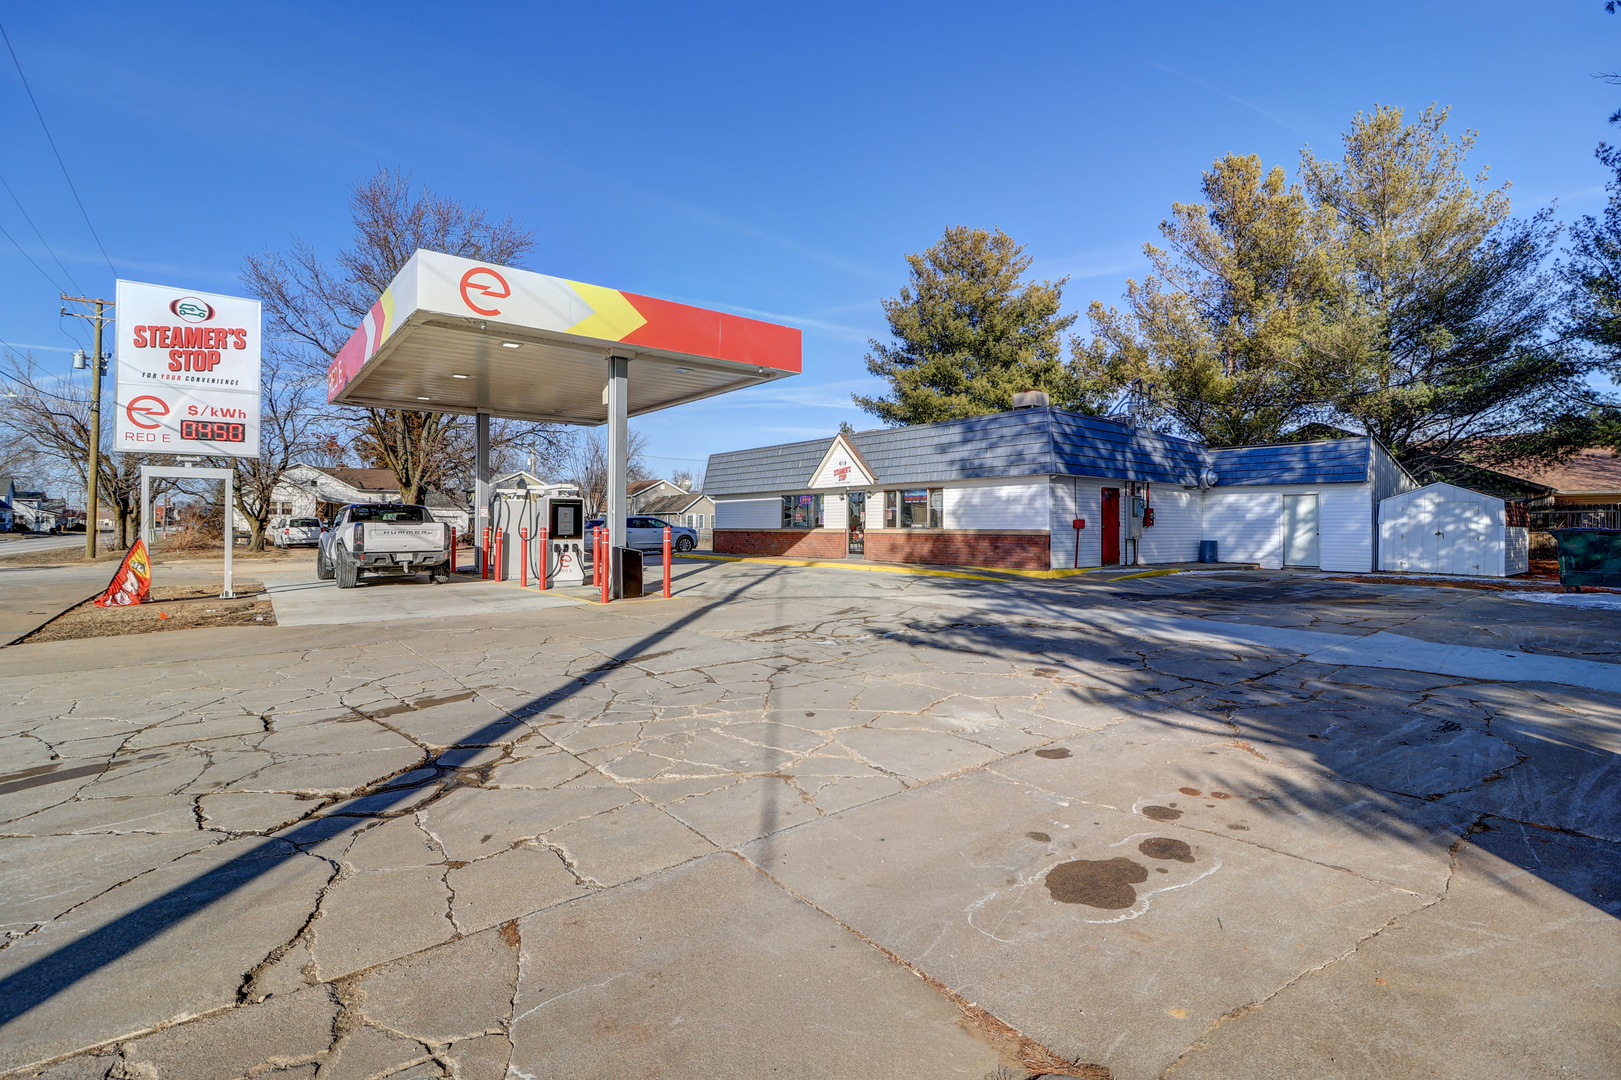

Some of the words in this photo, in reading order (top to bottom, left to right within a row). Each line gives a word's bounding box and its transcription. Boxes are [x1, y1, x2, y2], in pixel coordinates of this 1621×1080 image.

[133, 325, 247, 349] STEAMER'S
[168, 349, 221, 372] STOP
[141, 371, 158, 379] FOR
[160, 373, 182, 381] YOUR
[185, 375, 239, 386] CONVENIENCE
[187, 405, 247, 419] $/kWh
[125, 432, 156, 443] RED
[162, 433, 171, 443] E
